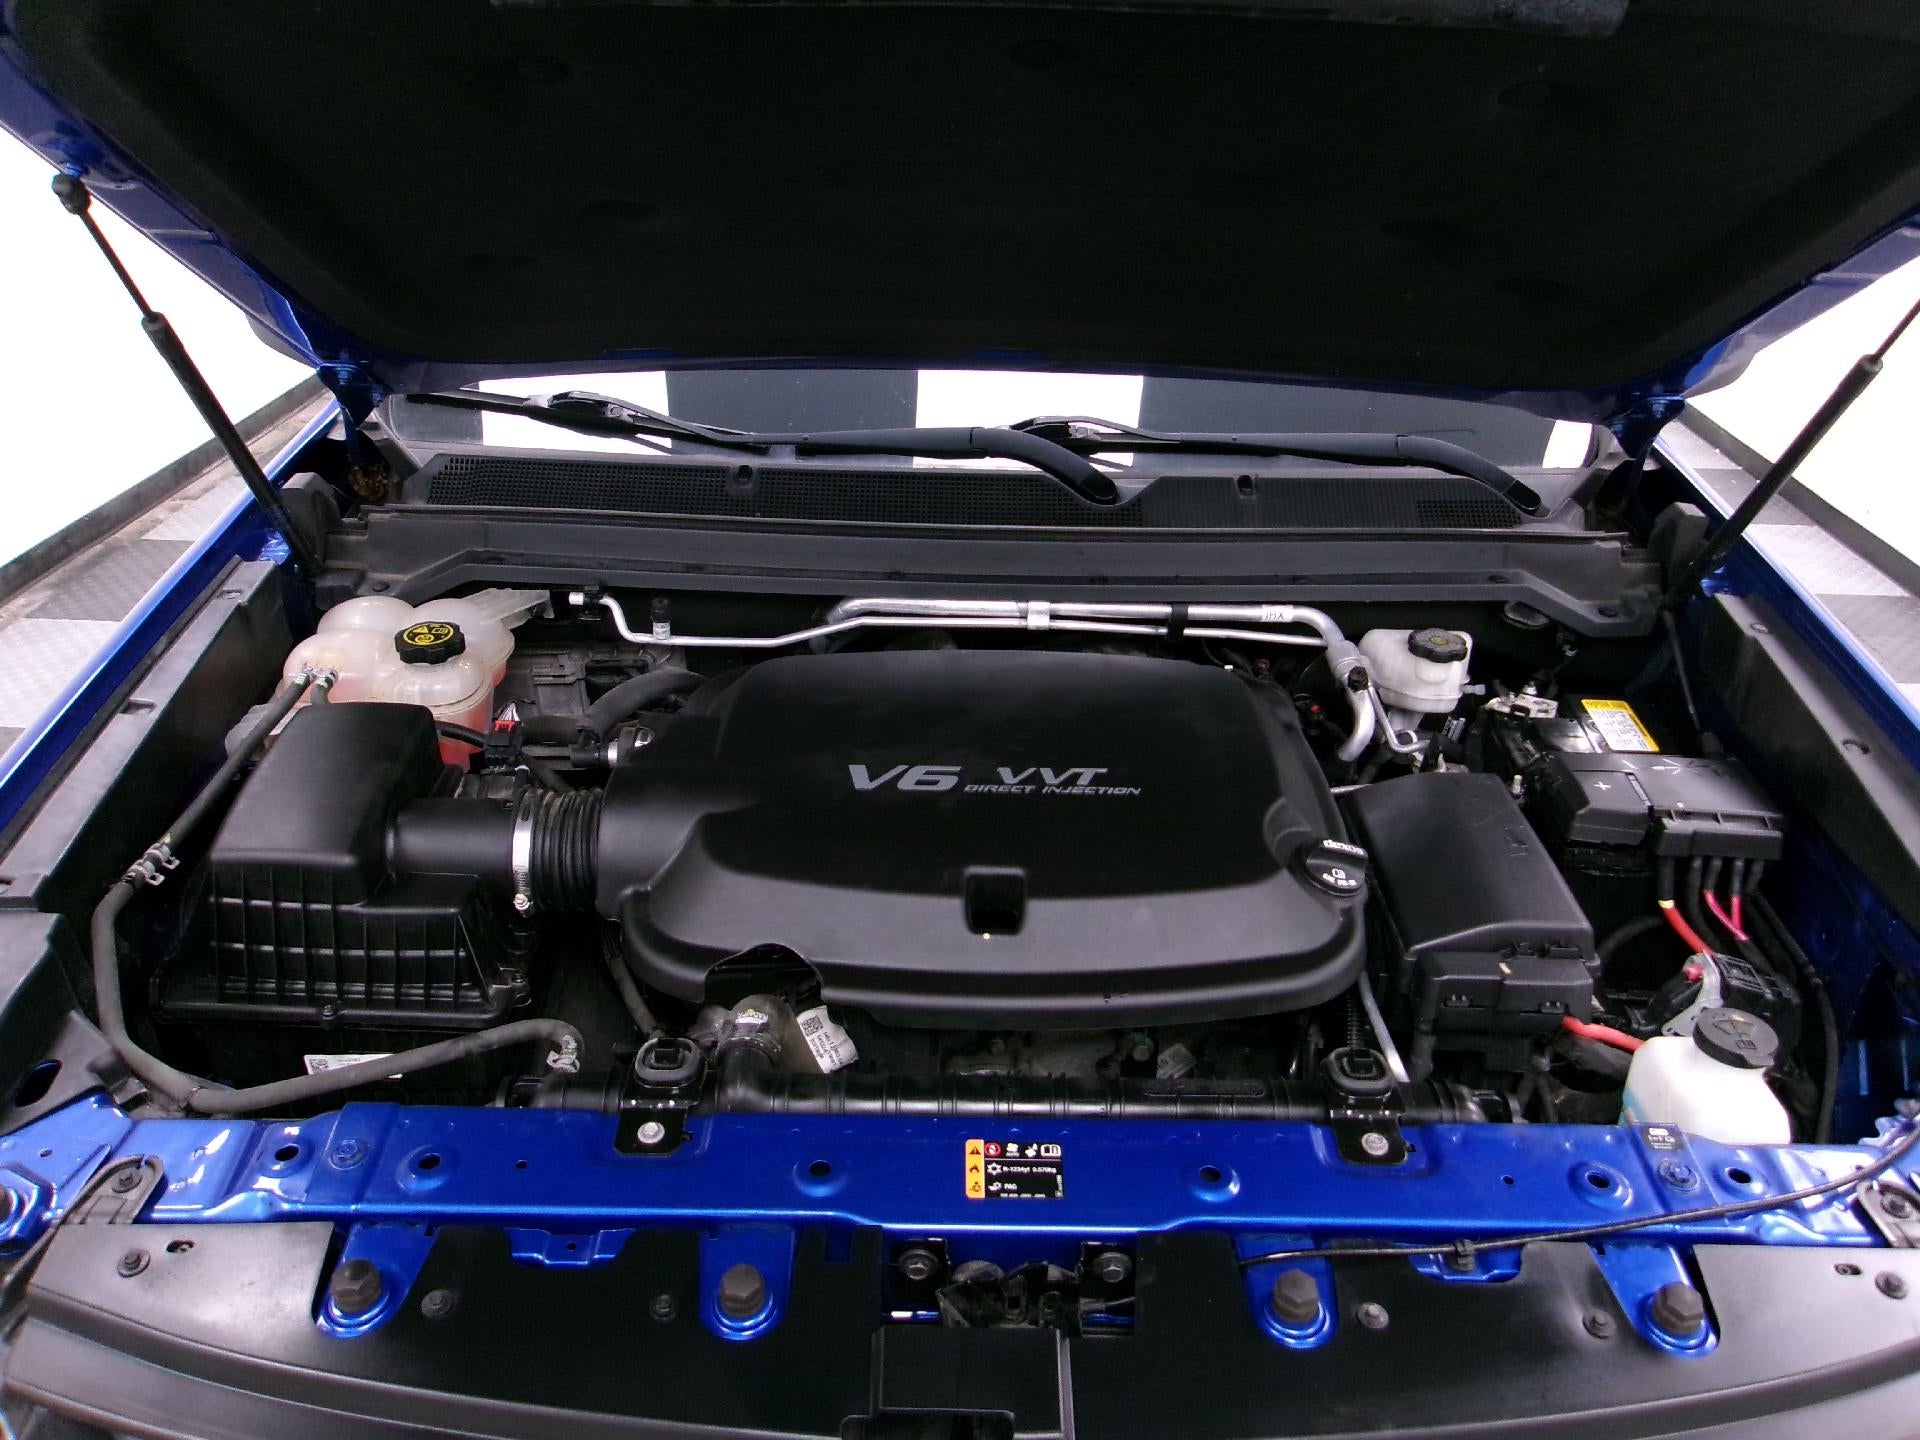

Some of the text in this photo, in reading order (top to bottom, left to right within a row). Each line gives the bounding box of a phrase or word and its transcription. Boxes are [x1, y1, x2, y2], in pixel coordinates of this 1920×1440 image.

[848, 764, 1108, 791] V6 VVT
[964, 784, 1141, 795] DIRECT INJECTION
